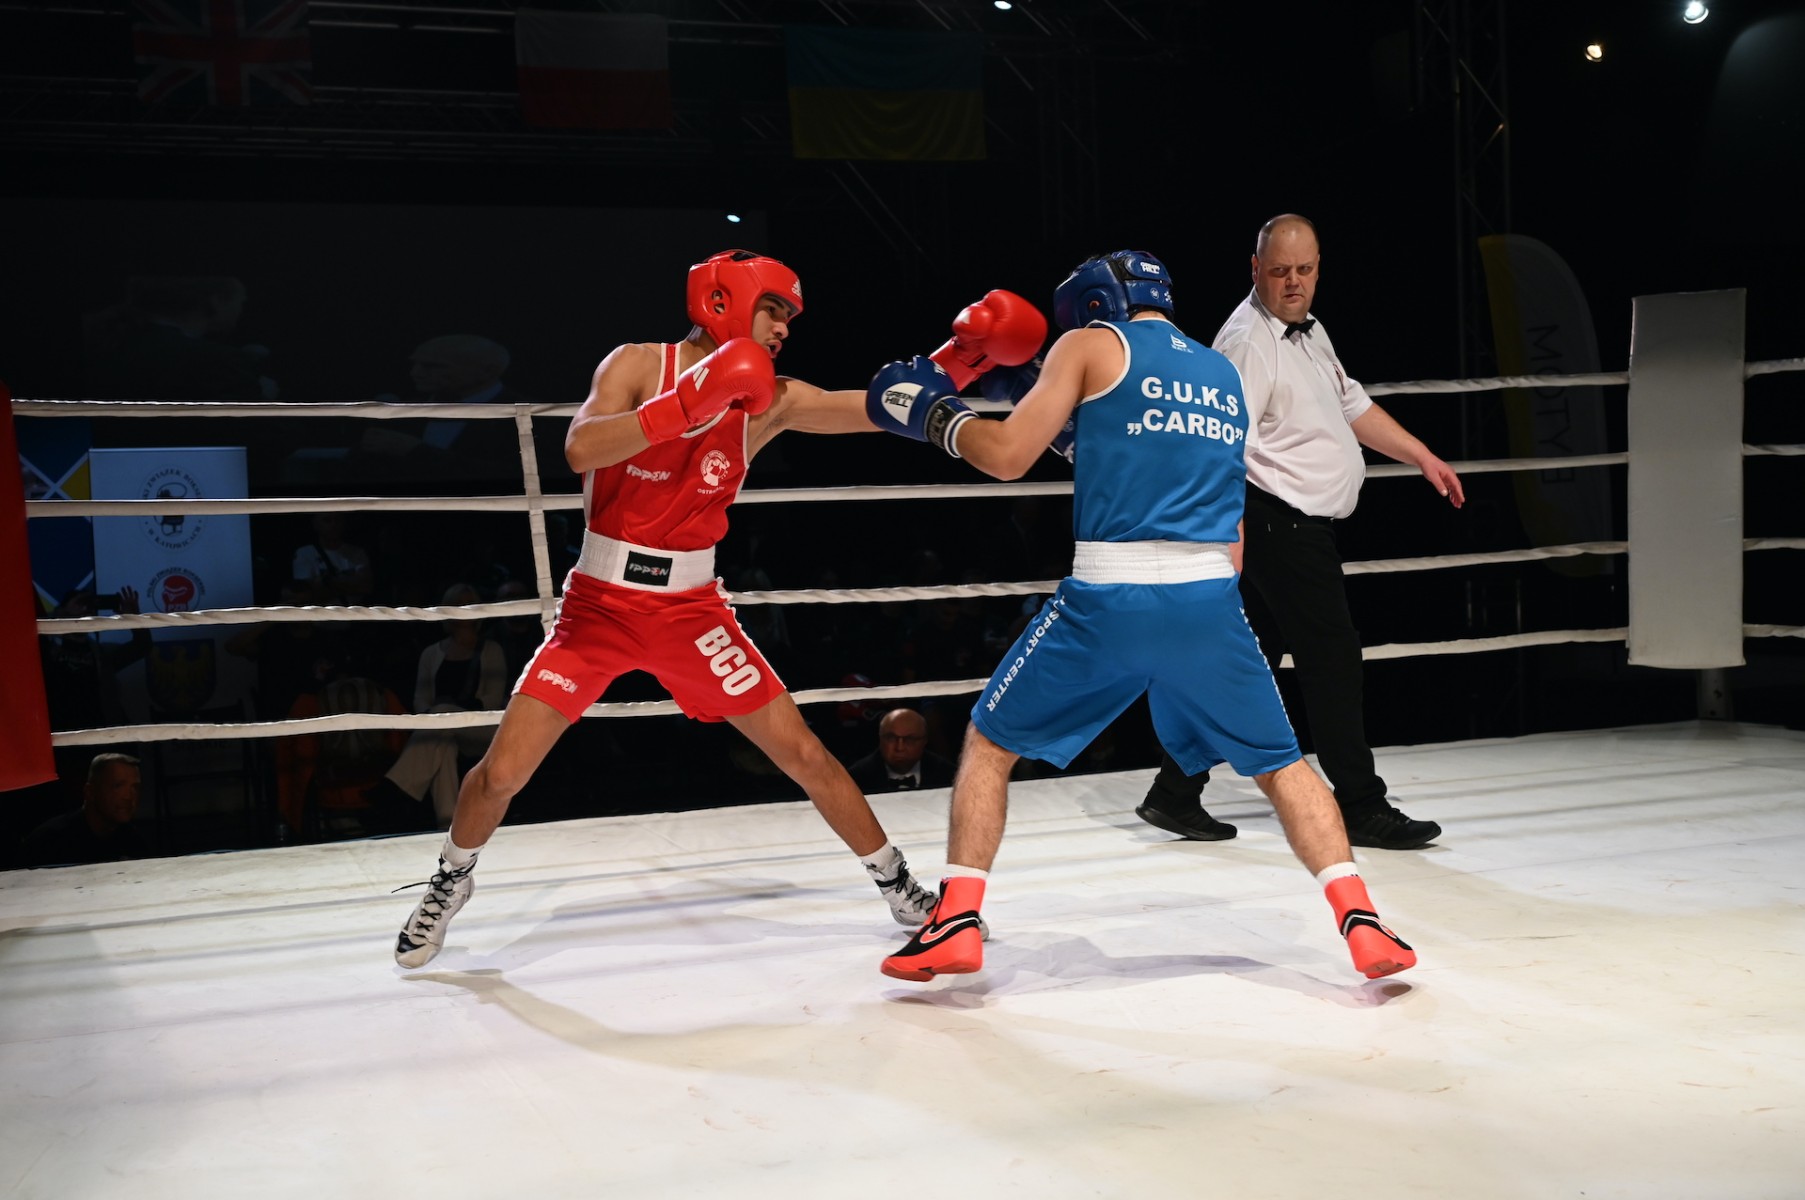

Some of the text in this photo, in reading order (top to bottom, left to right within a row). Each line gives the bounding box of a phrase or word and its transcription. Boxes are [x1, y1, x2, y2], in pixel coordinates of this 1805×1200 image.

[884, 397, 908, 407] HILL
[1141, 376, 1239, 417] G.U.K.S
[694, 624, 761, 696] BCO
[986, 610, 1060, 712] SPORT CENTER
